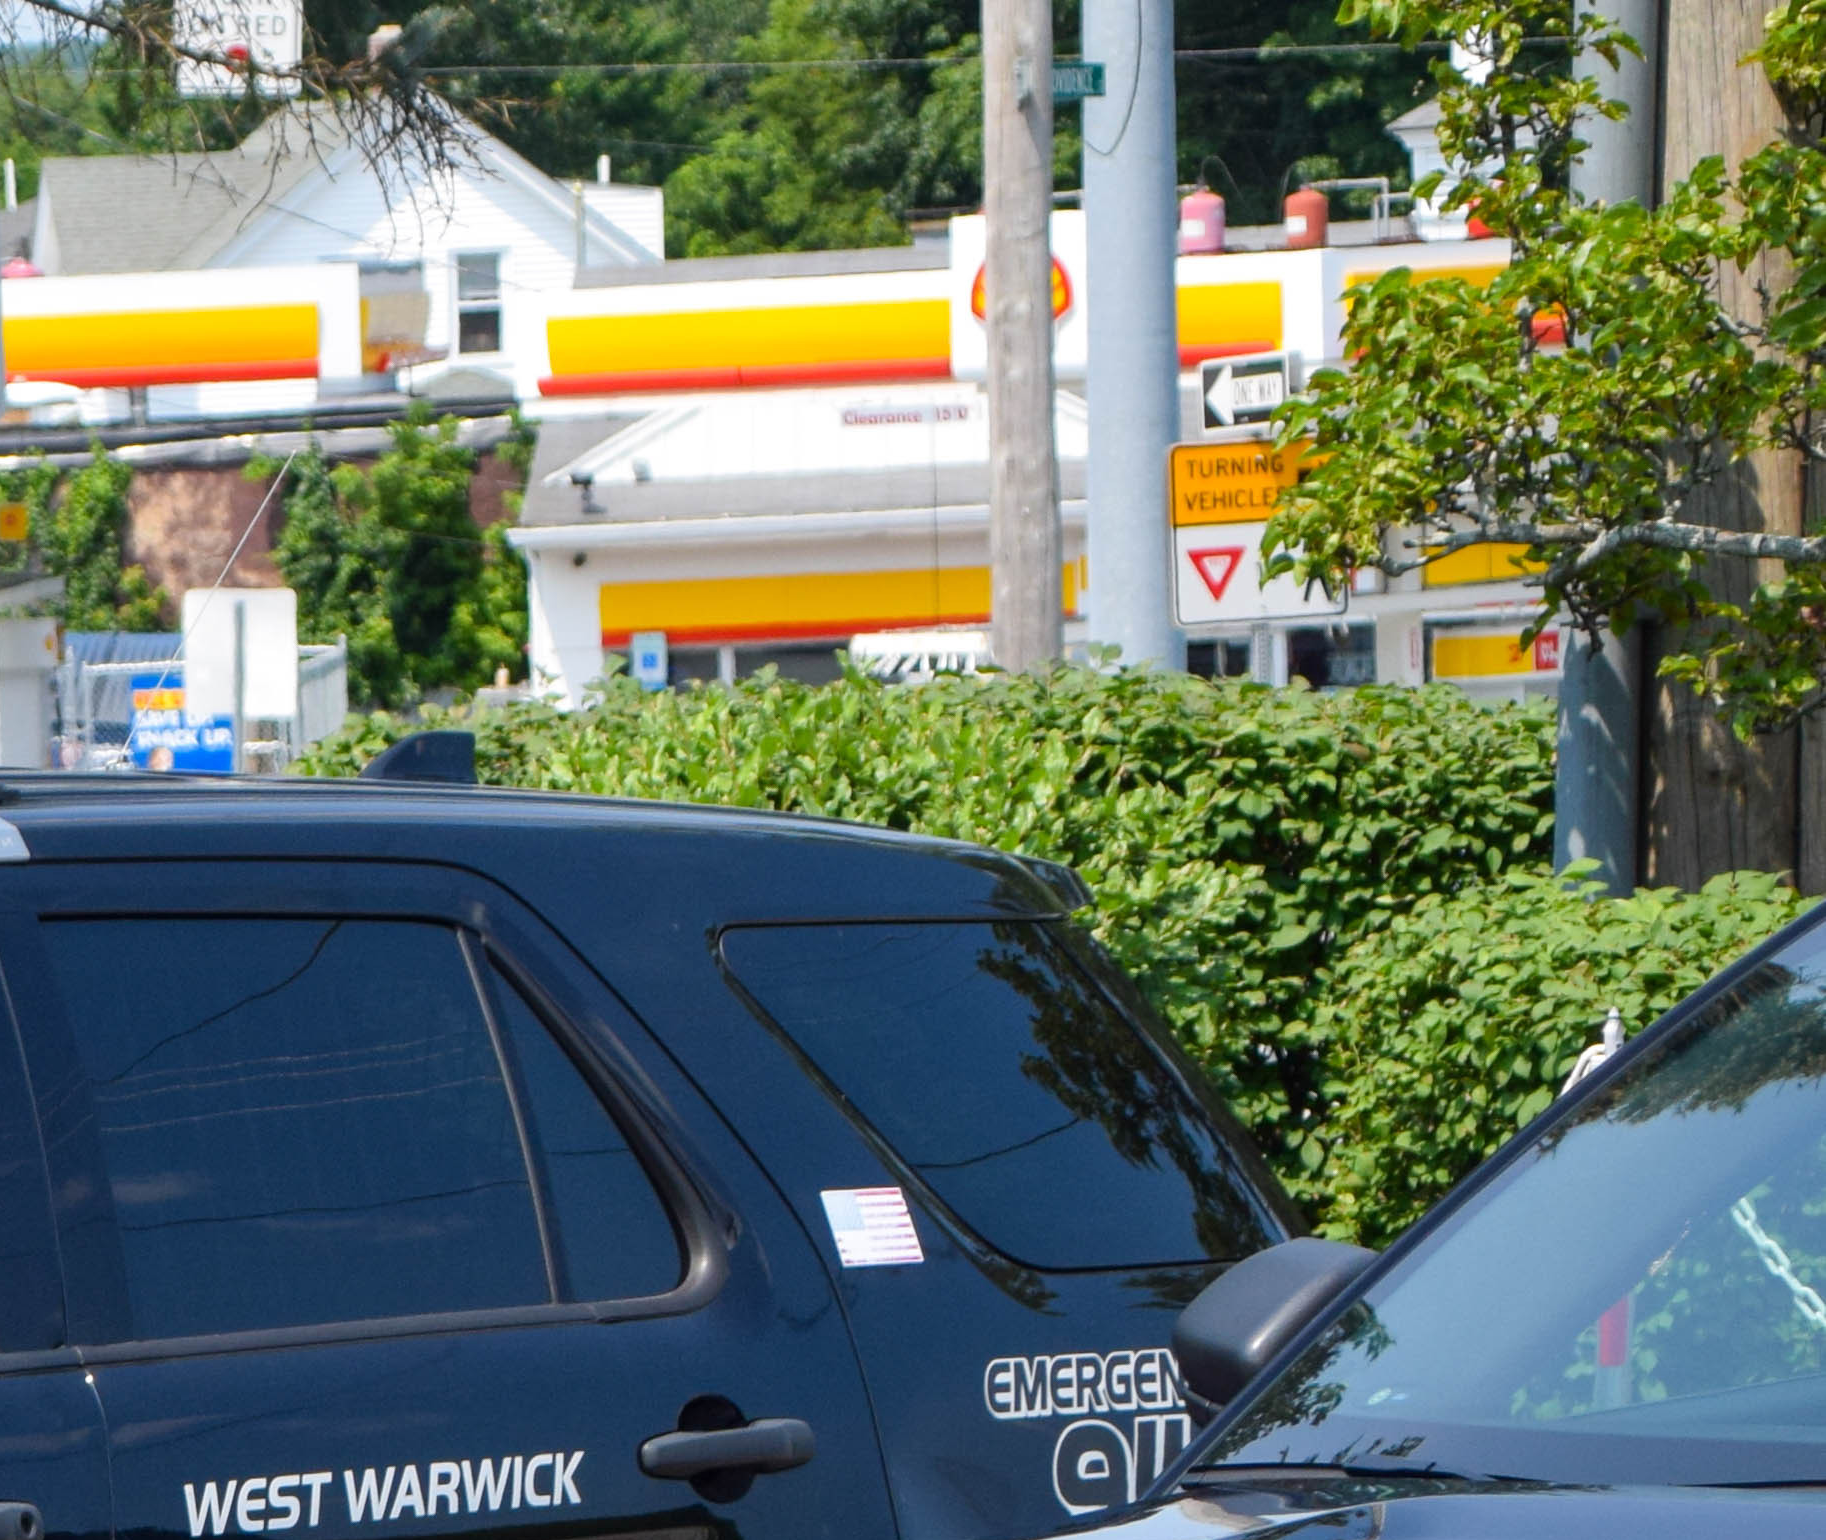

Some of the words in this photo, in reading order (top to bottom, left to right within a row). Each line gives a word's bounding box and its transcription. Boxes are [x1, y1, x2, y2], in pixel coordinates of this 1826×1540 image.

[237, 14, 287, 36] RED
[1233, 378, 1253, 405] ONE
[1259, 378, 1278, 401] WAY
[842, 409, 923, 426] Clearance
[1186, 454, 1285, 479] TURNING
[183, 1471, 333, 1538] WEST
[343, 1450, 585, 1524] WARWICK
